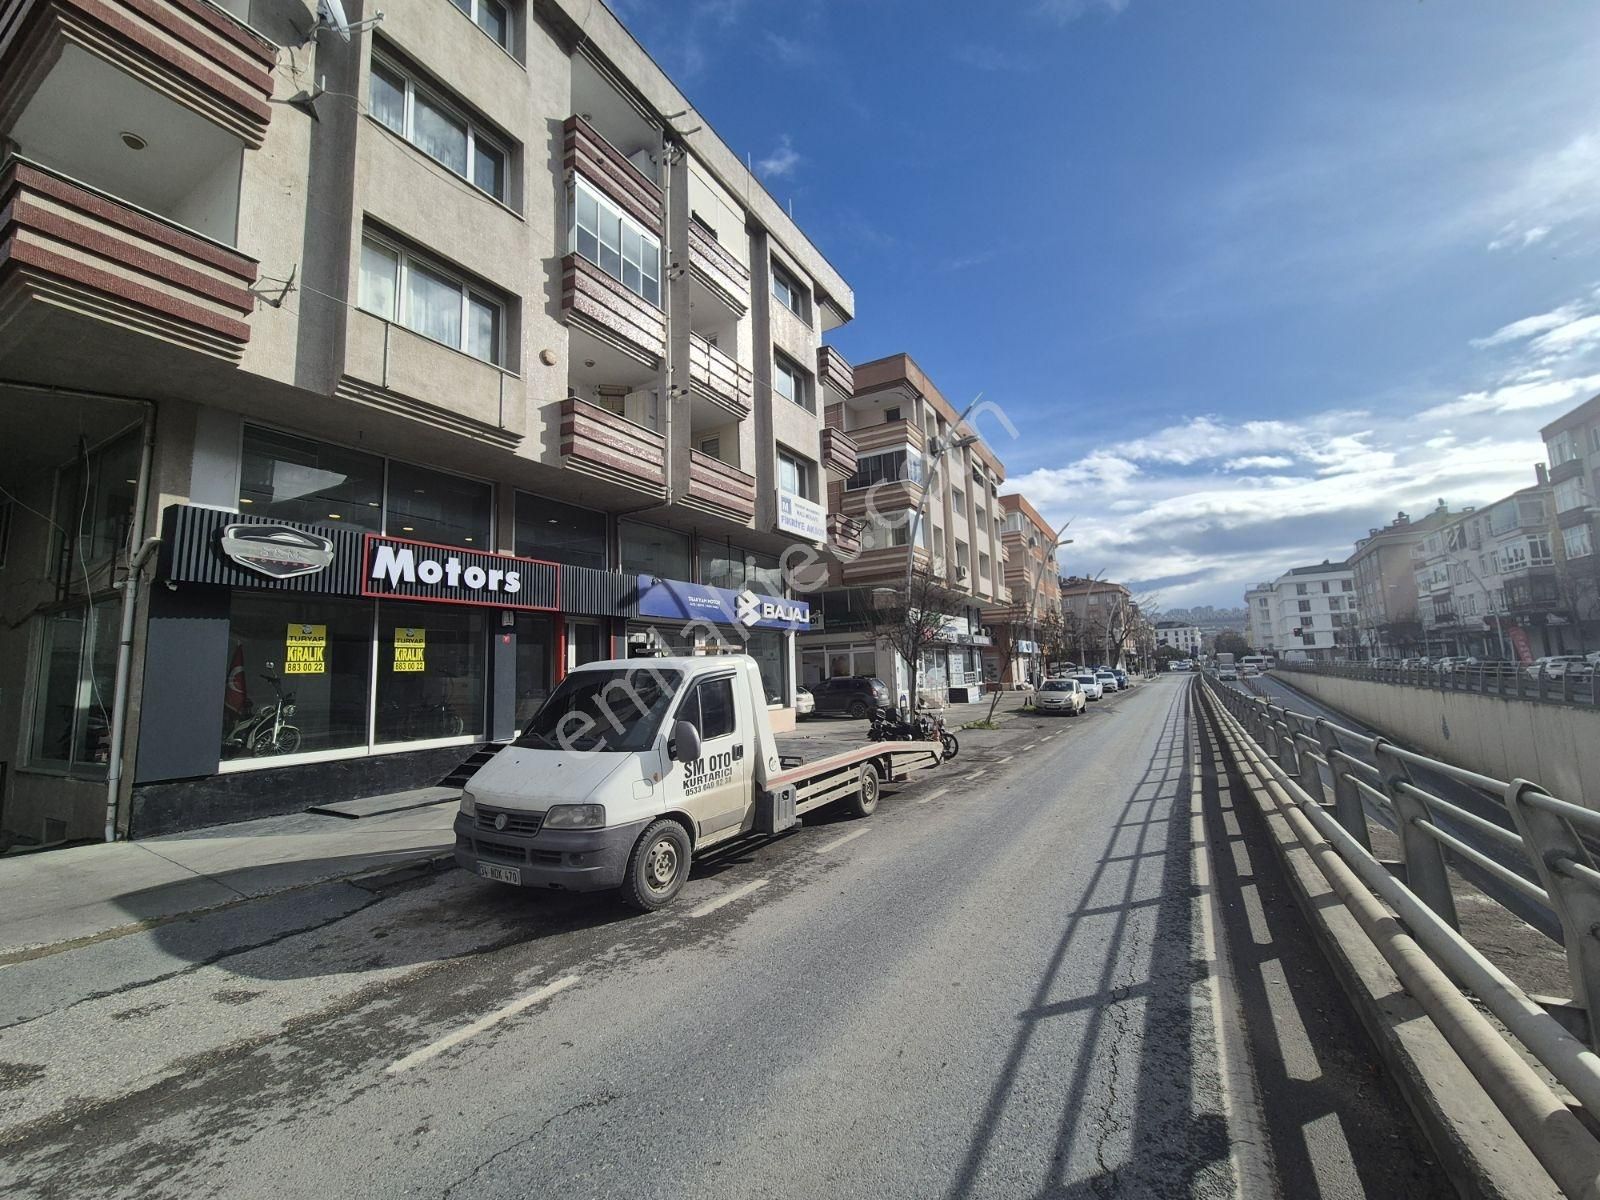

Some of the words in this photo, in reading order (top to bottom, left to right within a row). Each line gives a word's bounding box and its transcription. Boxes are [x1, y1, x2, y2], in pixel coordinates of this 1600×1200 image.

[372, 545, 521, 593] Motors
[763, 603, 810, 623] BAJAJ
[287, 662, 301, 671] 883
[303, 663, 312, 671] 00
[314, 663, 323, 671] 22
[408, 662, 415, 670] 00
[416, 662, 423, 670] 22
[684, 757, 704, 778] SM
[709, 752, 731, 771] OTO
[683, 767, 732, 789] KURTARICI
[685, 786, 701, 796] 0533
